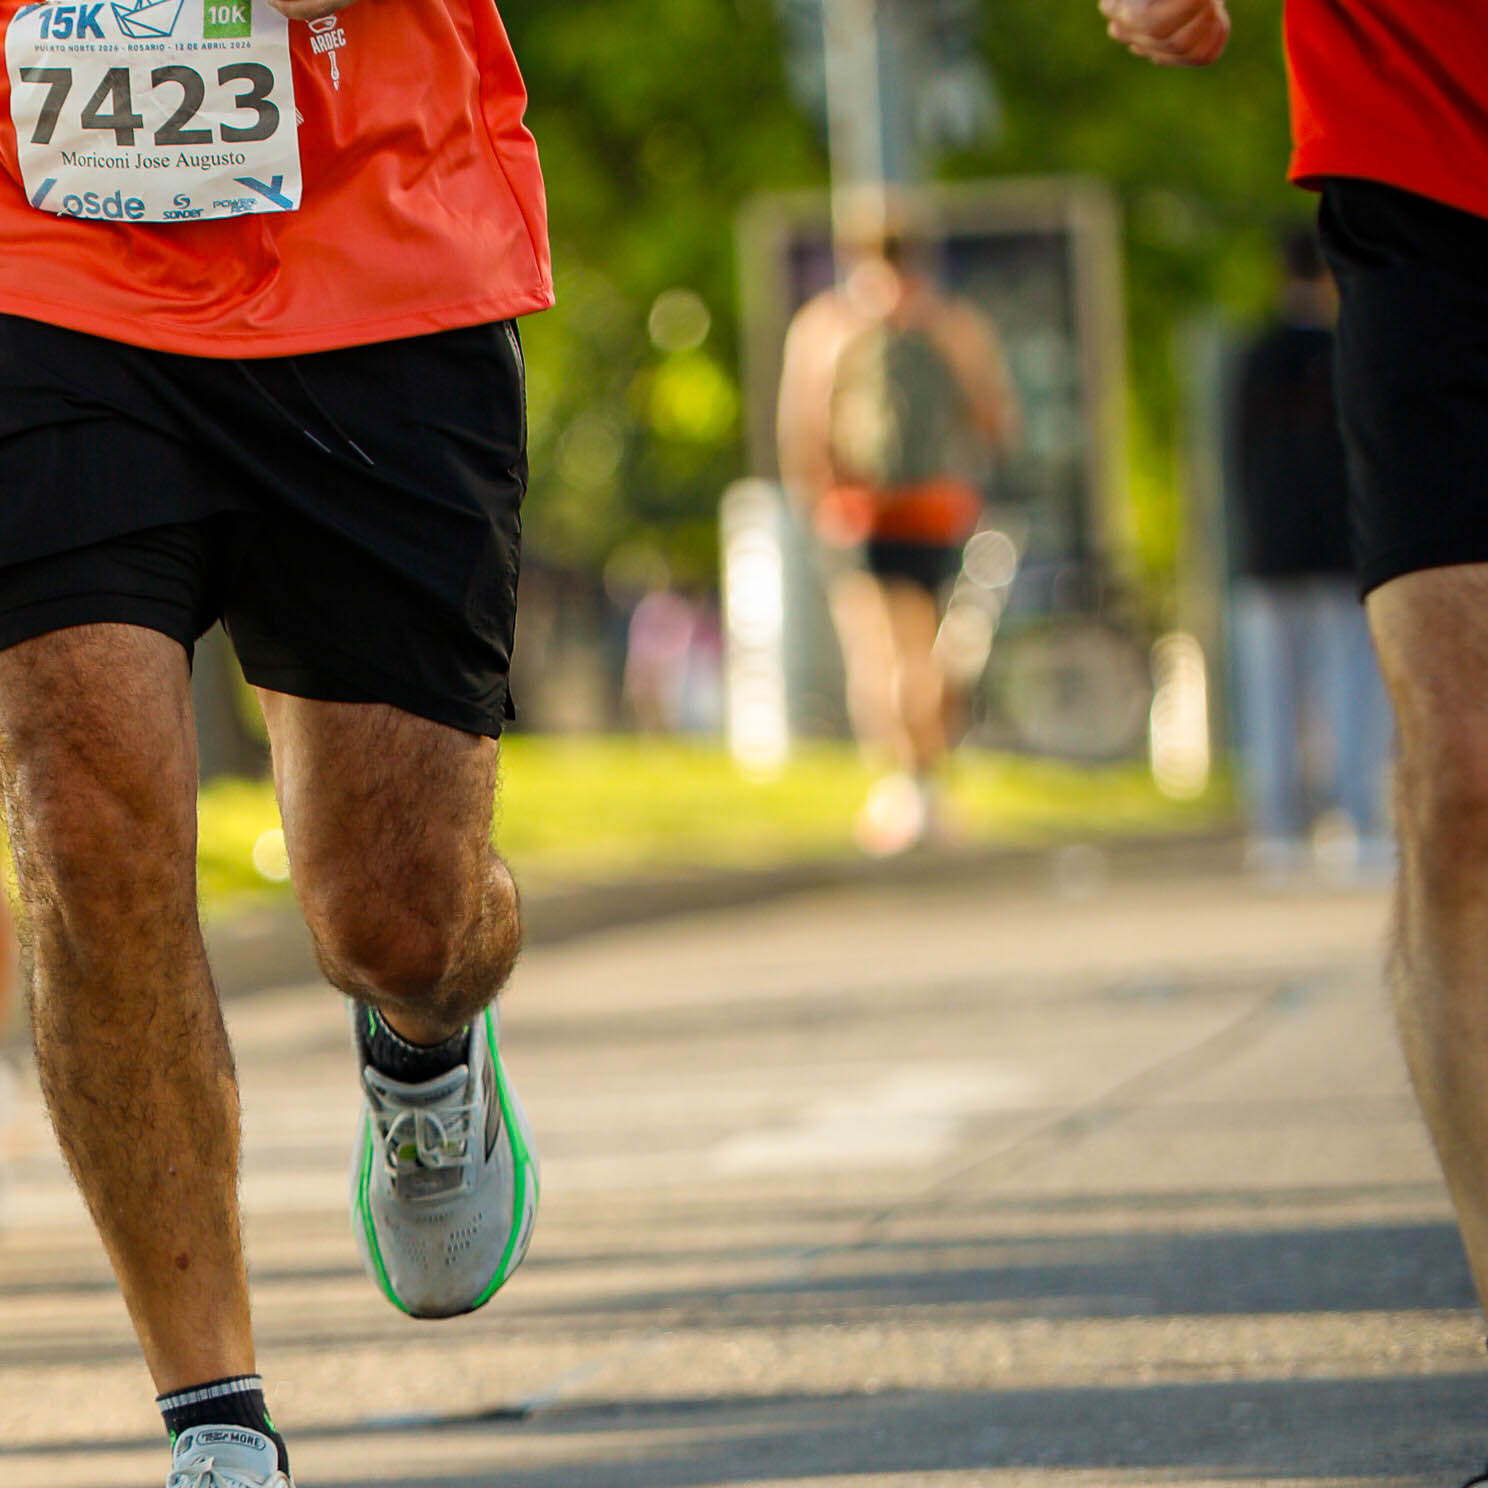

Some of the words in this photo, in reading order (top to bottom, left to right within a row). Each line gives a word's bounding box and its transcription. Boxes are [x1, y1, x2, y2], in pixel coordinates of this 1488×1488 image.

[39, 3, 105, 39] 15K
[208, 5, 246, 24] 10K
[128, 43, 165, 52] ROSARIO
[201, 42, 227, 50] ABRIL
[310, 28, 347, 55] ARDEC
[19, 62, 280, 147] 7423
[61, 151, 129, 169] Moriconi
[135, 153, 170, 169] Jose
[176, 151, 246, 171] Augusto
[63, 189, 146, 220] osde
